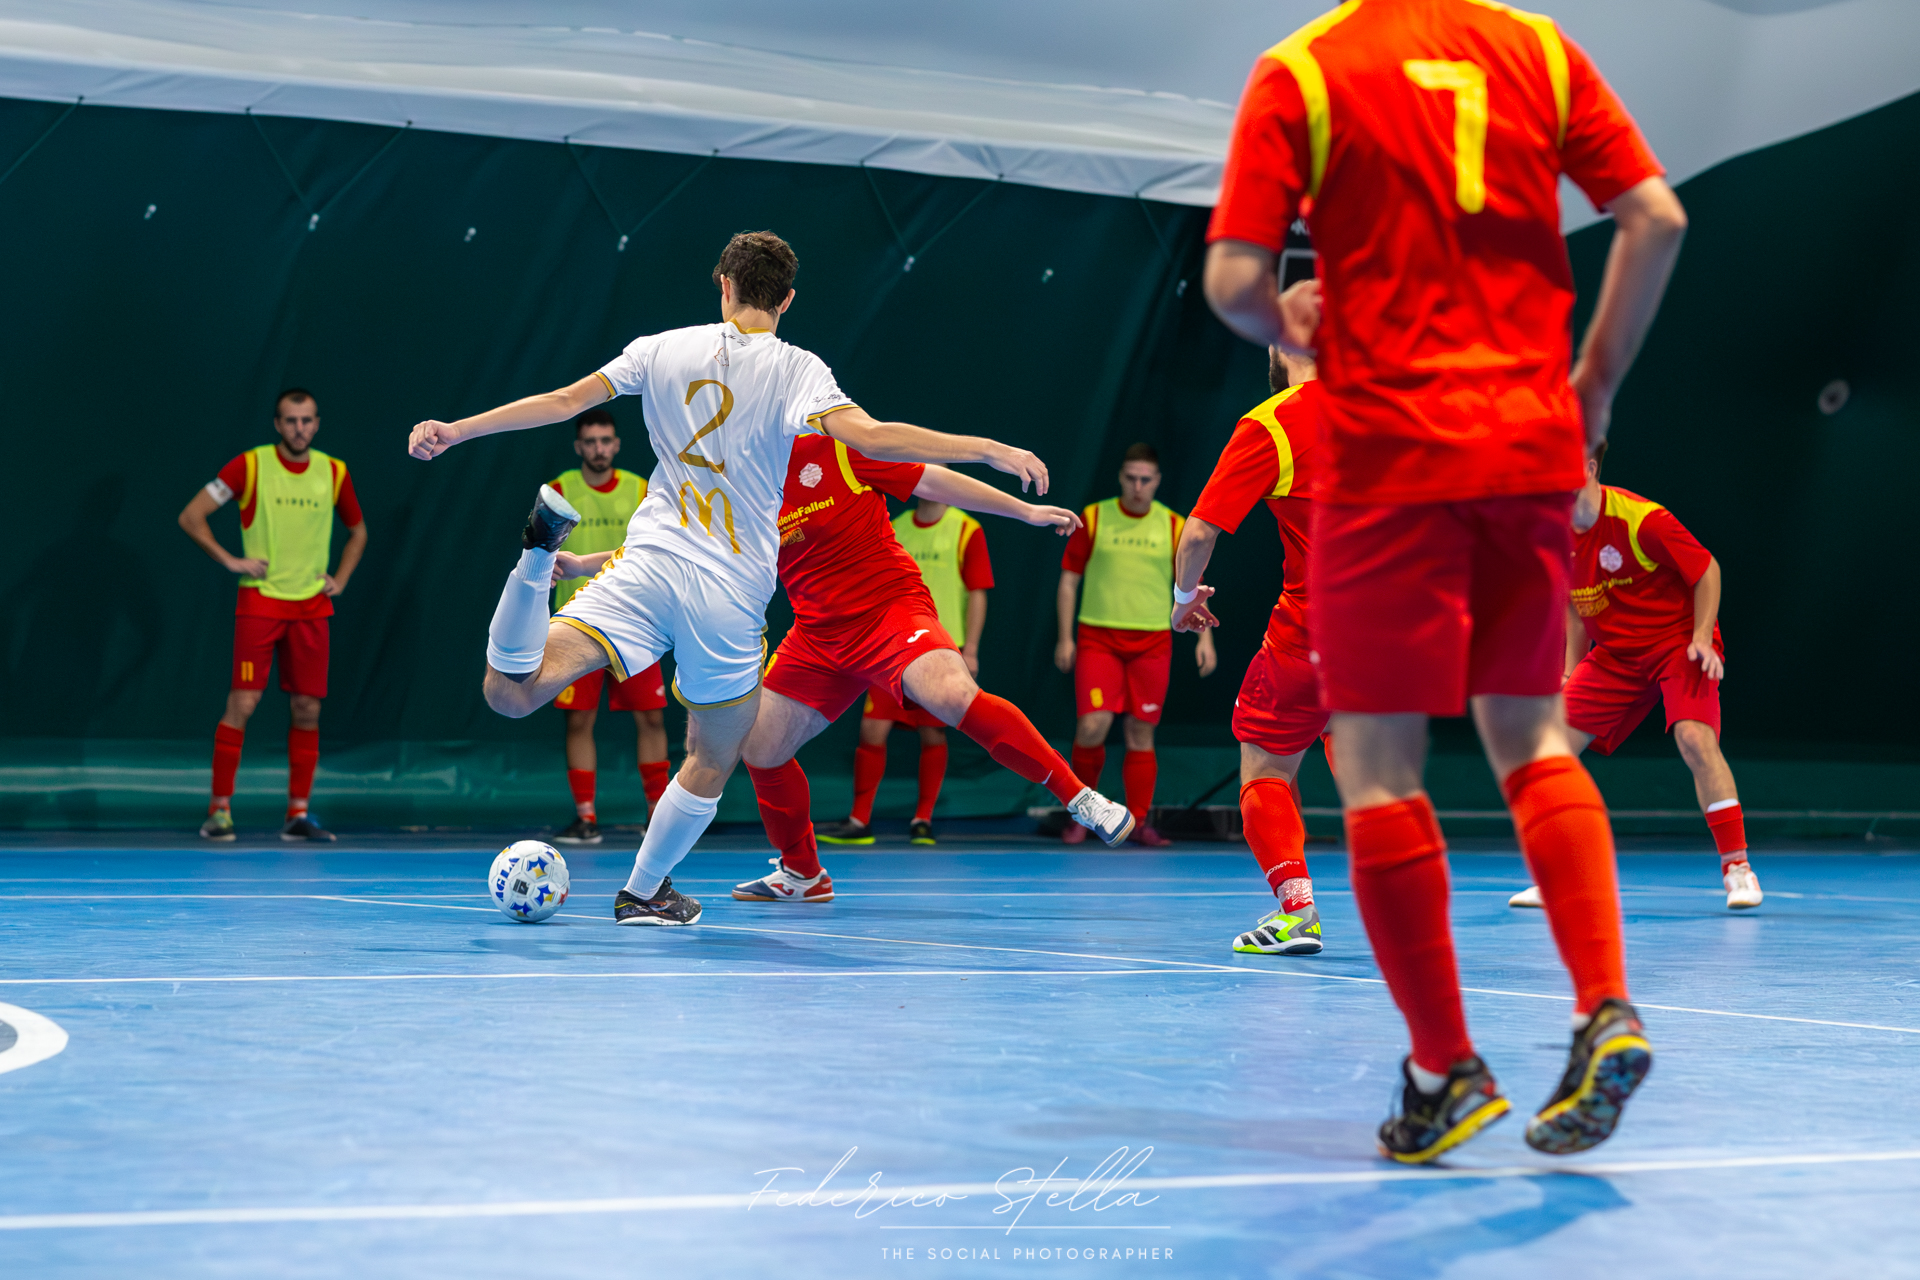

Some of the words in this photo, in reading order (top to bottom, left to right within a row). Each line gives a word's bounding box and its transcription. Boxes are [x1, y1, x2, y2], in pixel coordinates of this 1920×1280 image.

[1402, 58, 1489, 215] 7
[678, 378, 735, 475] 2
[241, 660, 255, 682] 11
